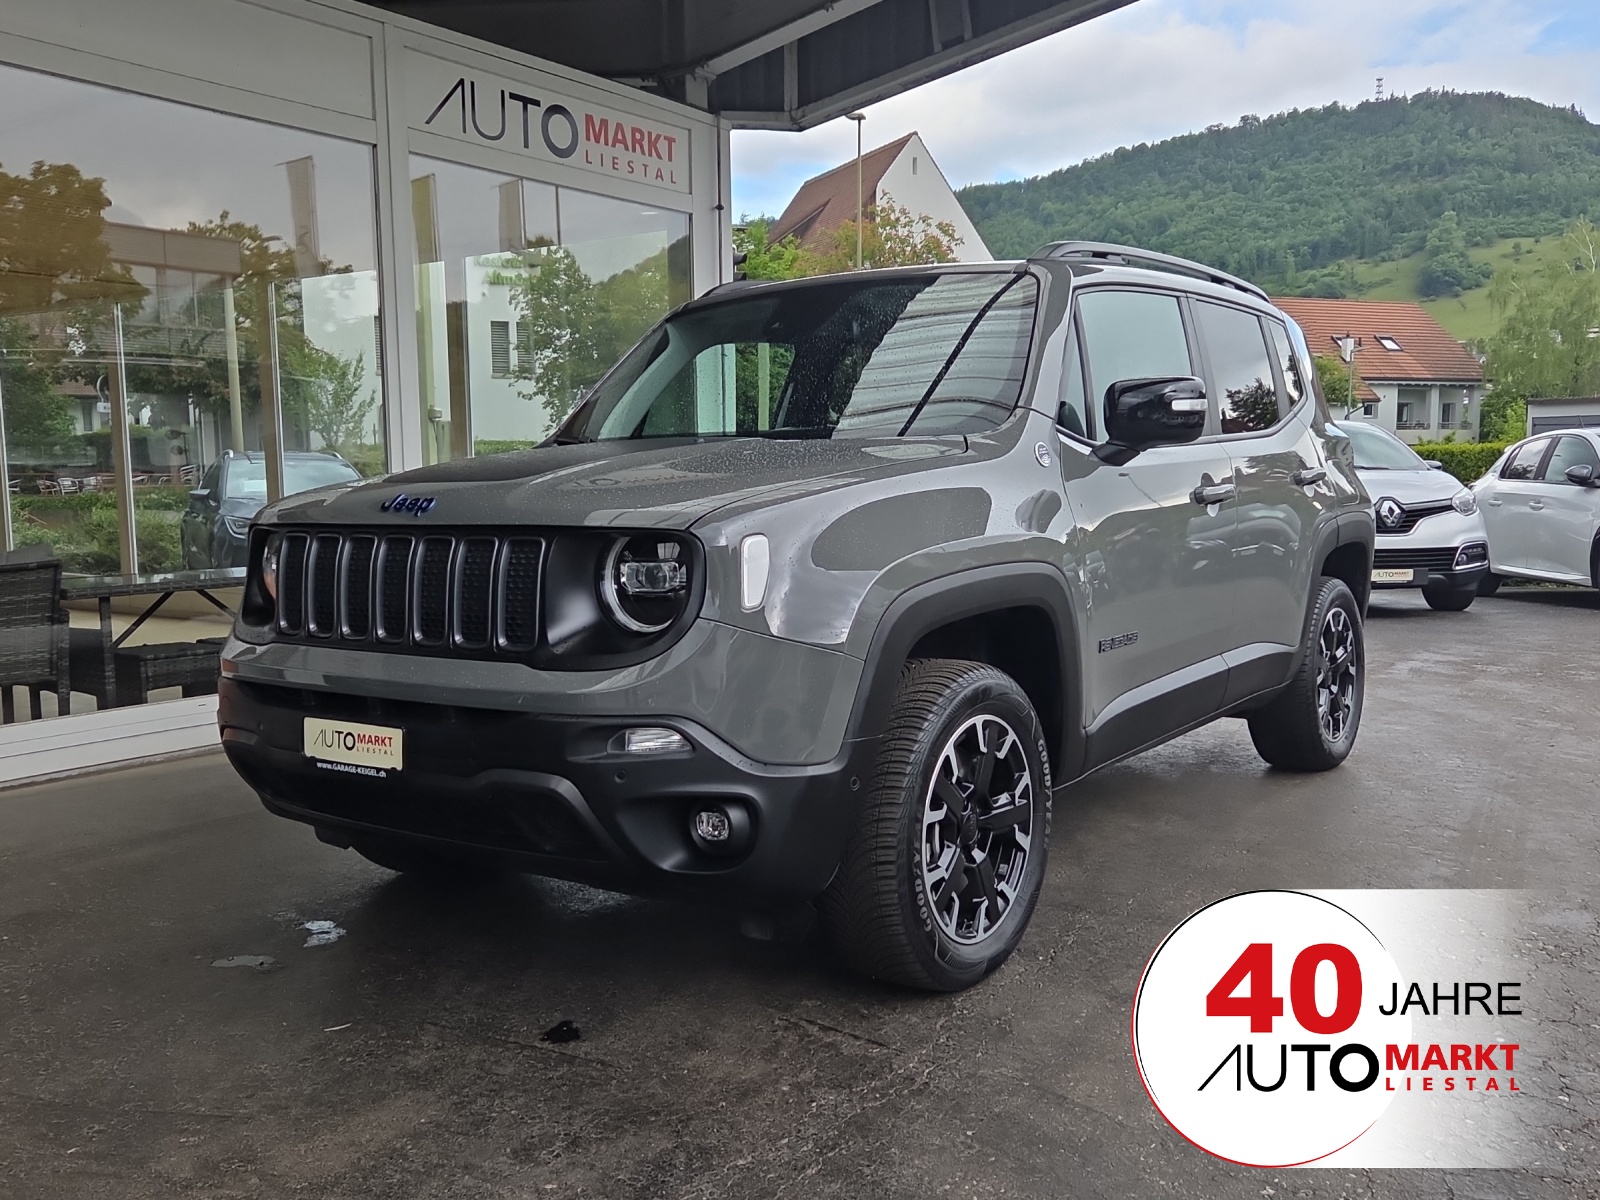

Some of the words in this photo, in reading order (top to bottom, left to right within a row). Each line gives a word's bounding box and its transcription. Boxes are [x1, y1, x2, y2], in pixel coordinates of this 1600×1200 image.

[584, 113, 676, 162] MARKT
[585, 149, 677, 184] LIESTAL
[380, 493, 436, 517] Jeep
[356, 733, 393, 747] MARKT
[356, 747, 394, 756] LIESTAL
